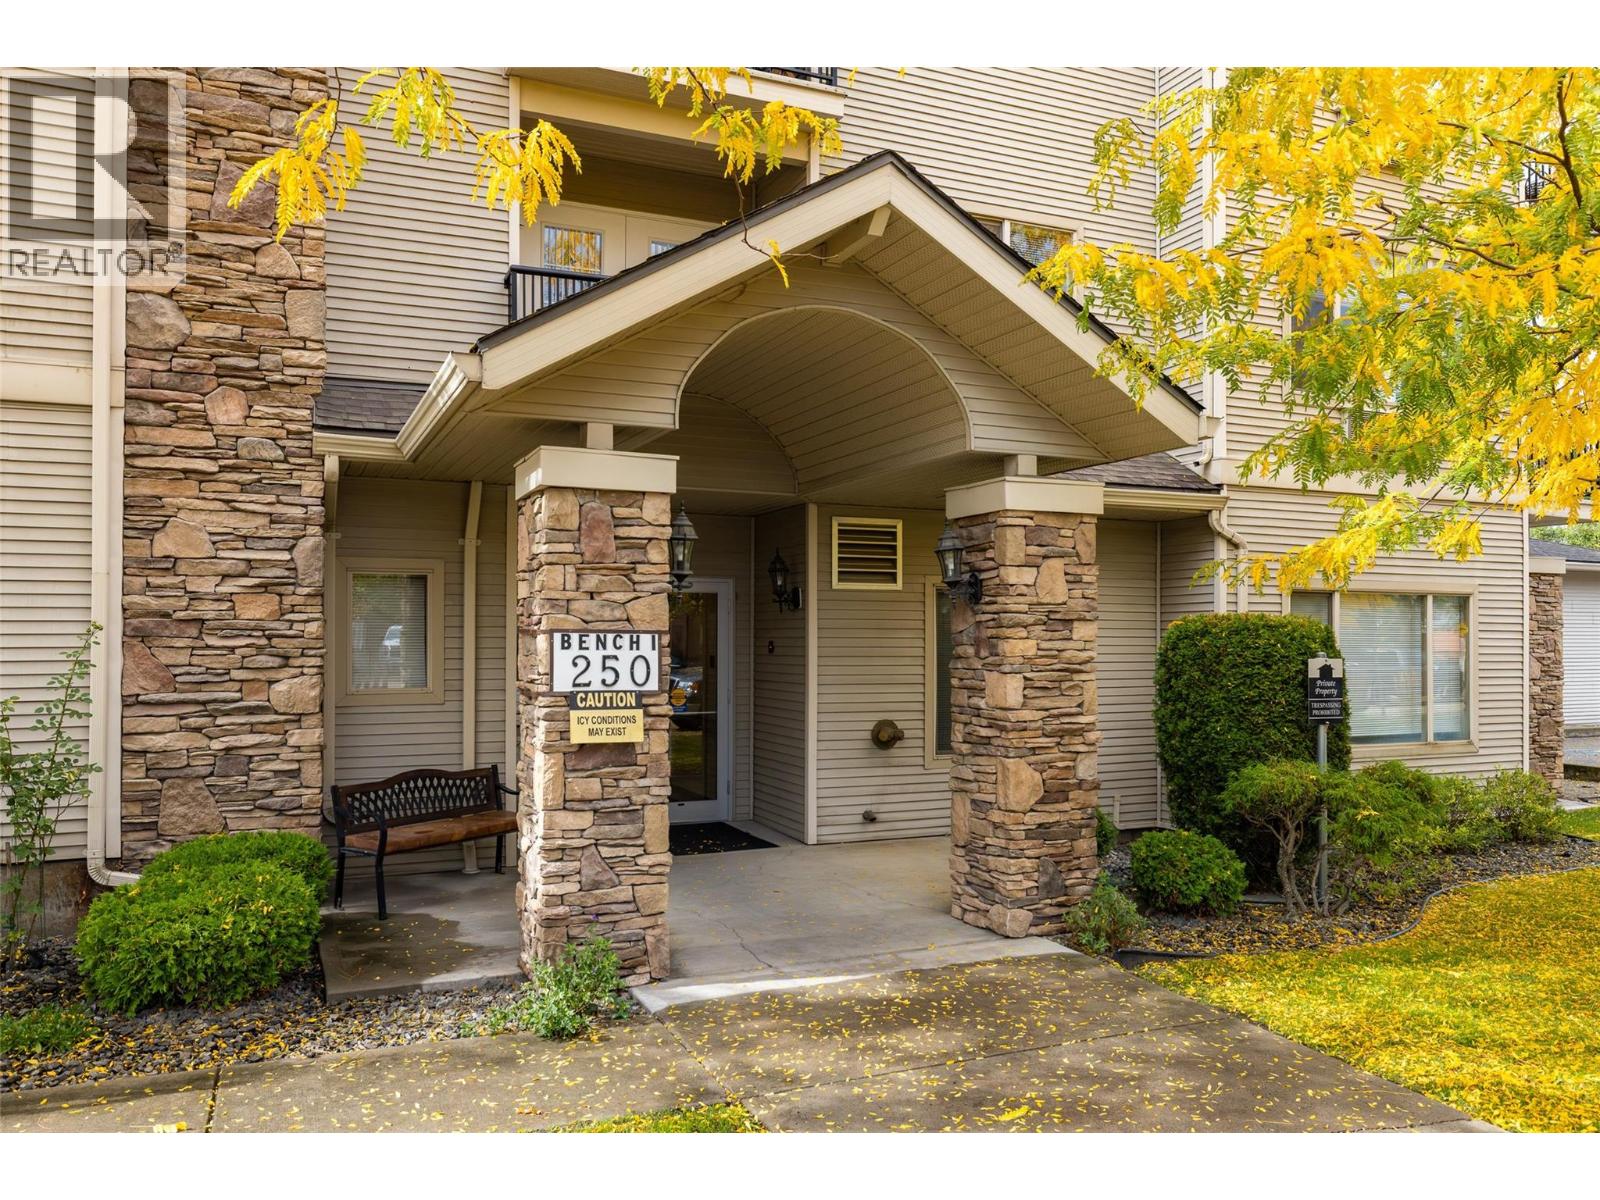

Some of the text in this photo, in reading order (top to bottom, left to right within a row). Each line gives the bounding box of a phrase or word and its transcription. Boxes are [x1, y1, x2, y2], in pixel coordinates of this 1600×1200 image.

[561, 633, 640, 651] BENCH
[571, 654, 651, 687] 250
[1315, 688, 1337, 697] Property
[576, 692, 636, 708] CAUTION
[577, 715, 637, 725] ICY CONDITIONS
[588, 727, 627, 736] MAY EXIST
